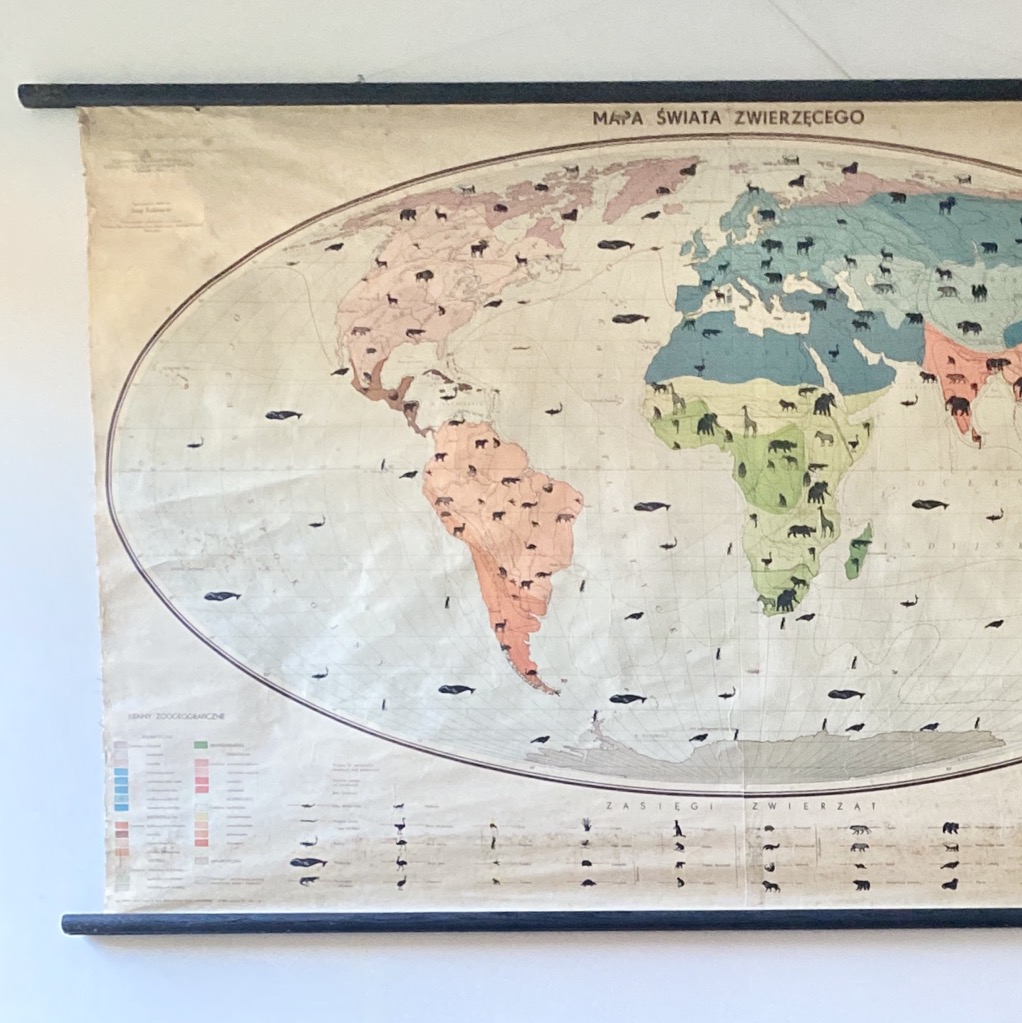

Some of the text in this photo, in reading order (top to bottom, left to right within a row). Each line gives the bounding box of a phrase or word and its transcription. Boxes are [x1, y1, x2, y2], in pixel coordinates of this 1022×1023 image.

[593, 107, 865, 127] MAPA ŚWIATA ZWIERZĘCEGO
[606, 801, 877, 813] ZASIĘGI ZWIERZĄT
